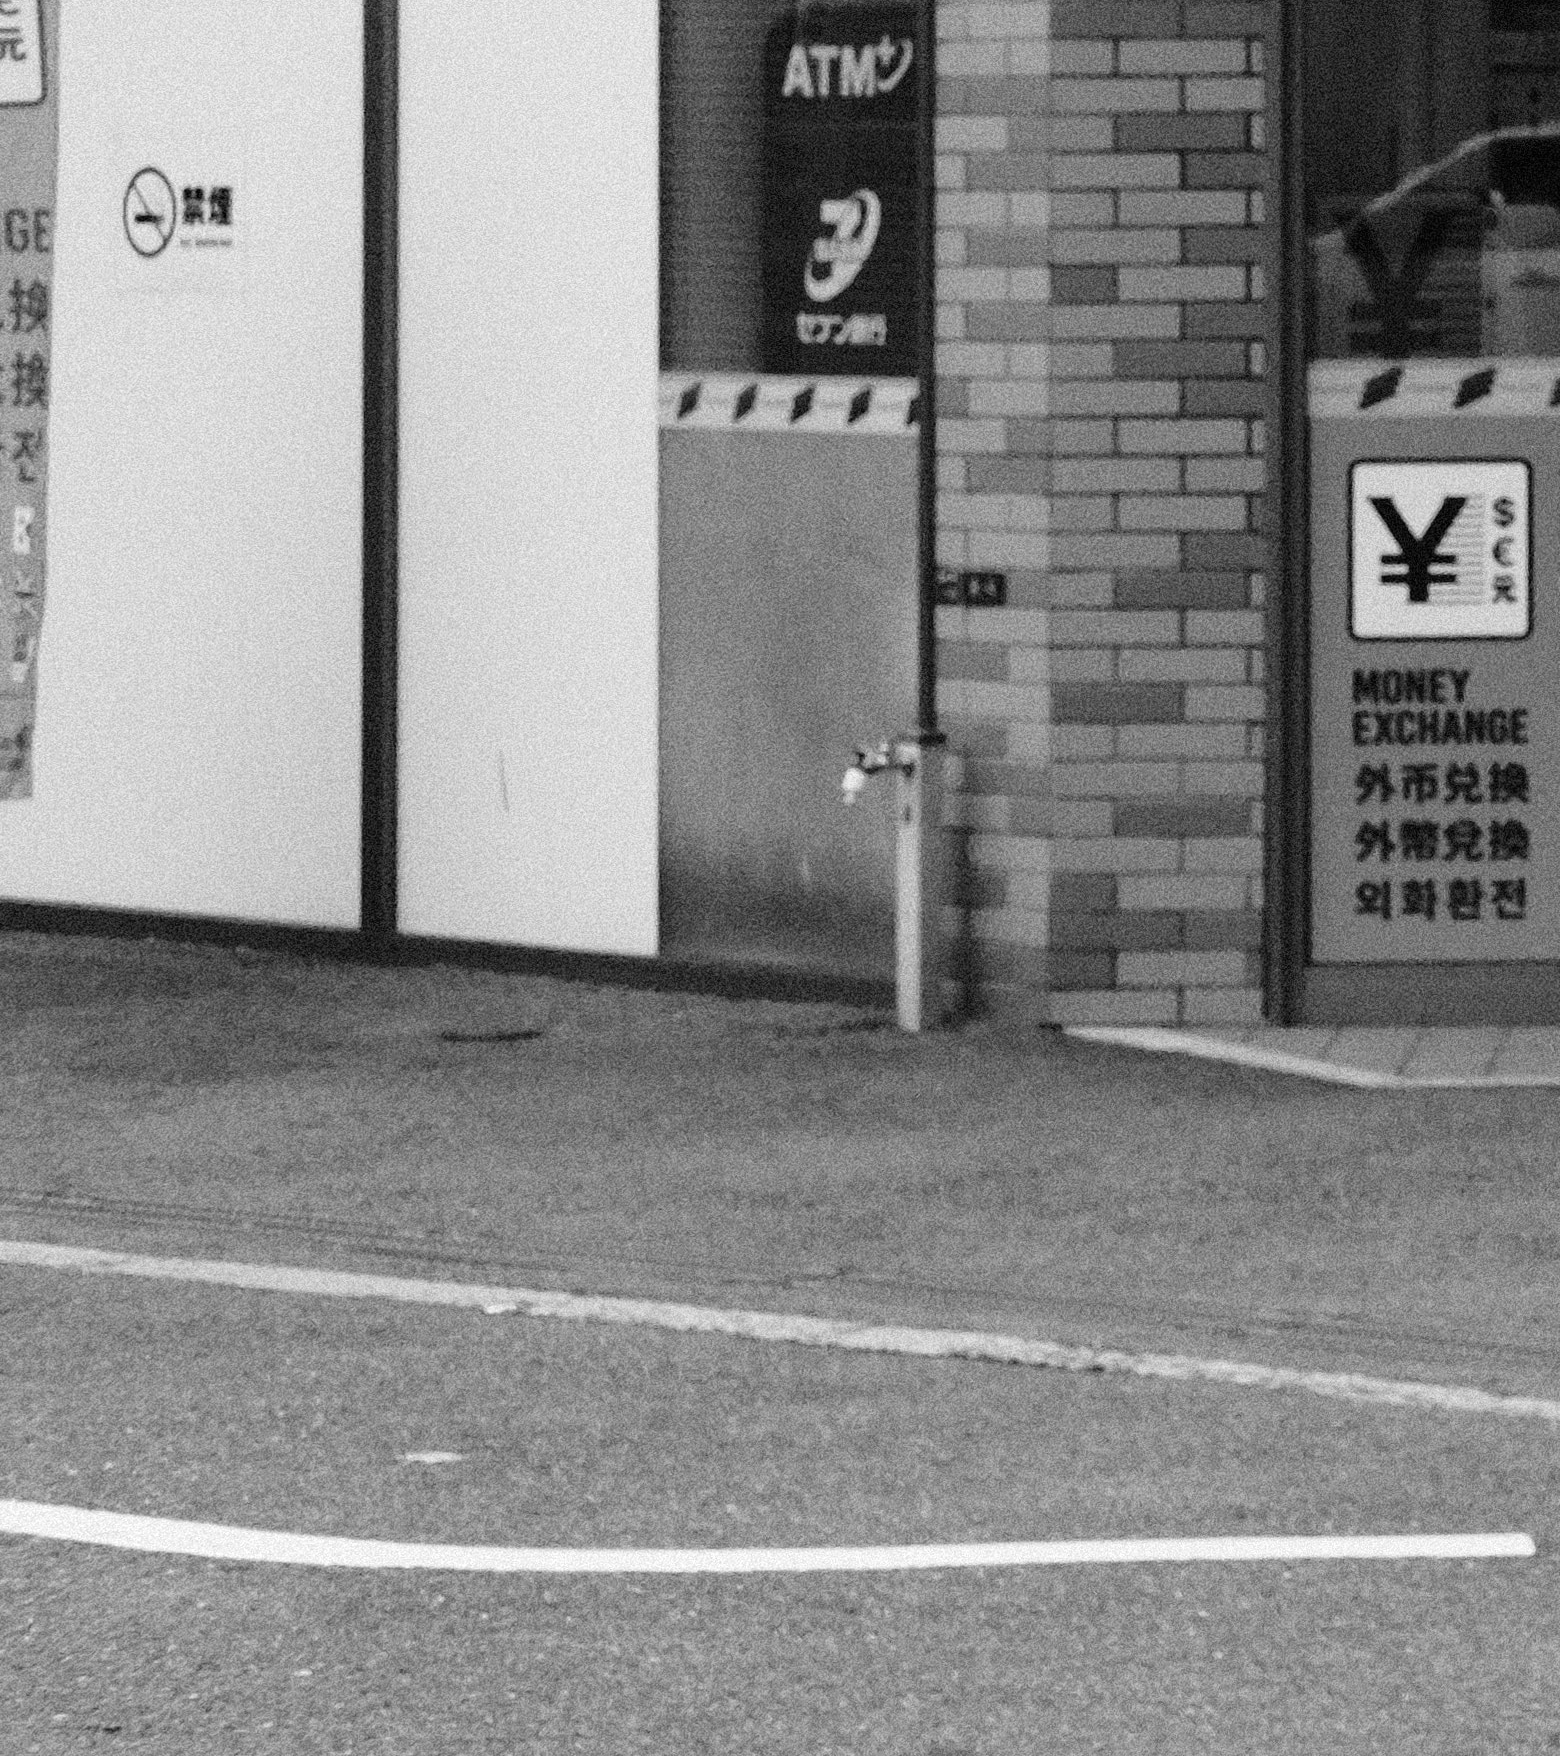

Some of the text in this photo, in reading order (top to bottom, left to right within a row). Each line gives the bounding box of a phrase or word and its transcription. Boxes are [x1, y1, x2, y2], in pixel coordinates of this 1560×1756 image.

[782, 43, 876, 98] ATM
[1352, 668, 1470, 706] MONEY
[1352, 707, 1529, 746] EXCHANGE
